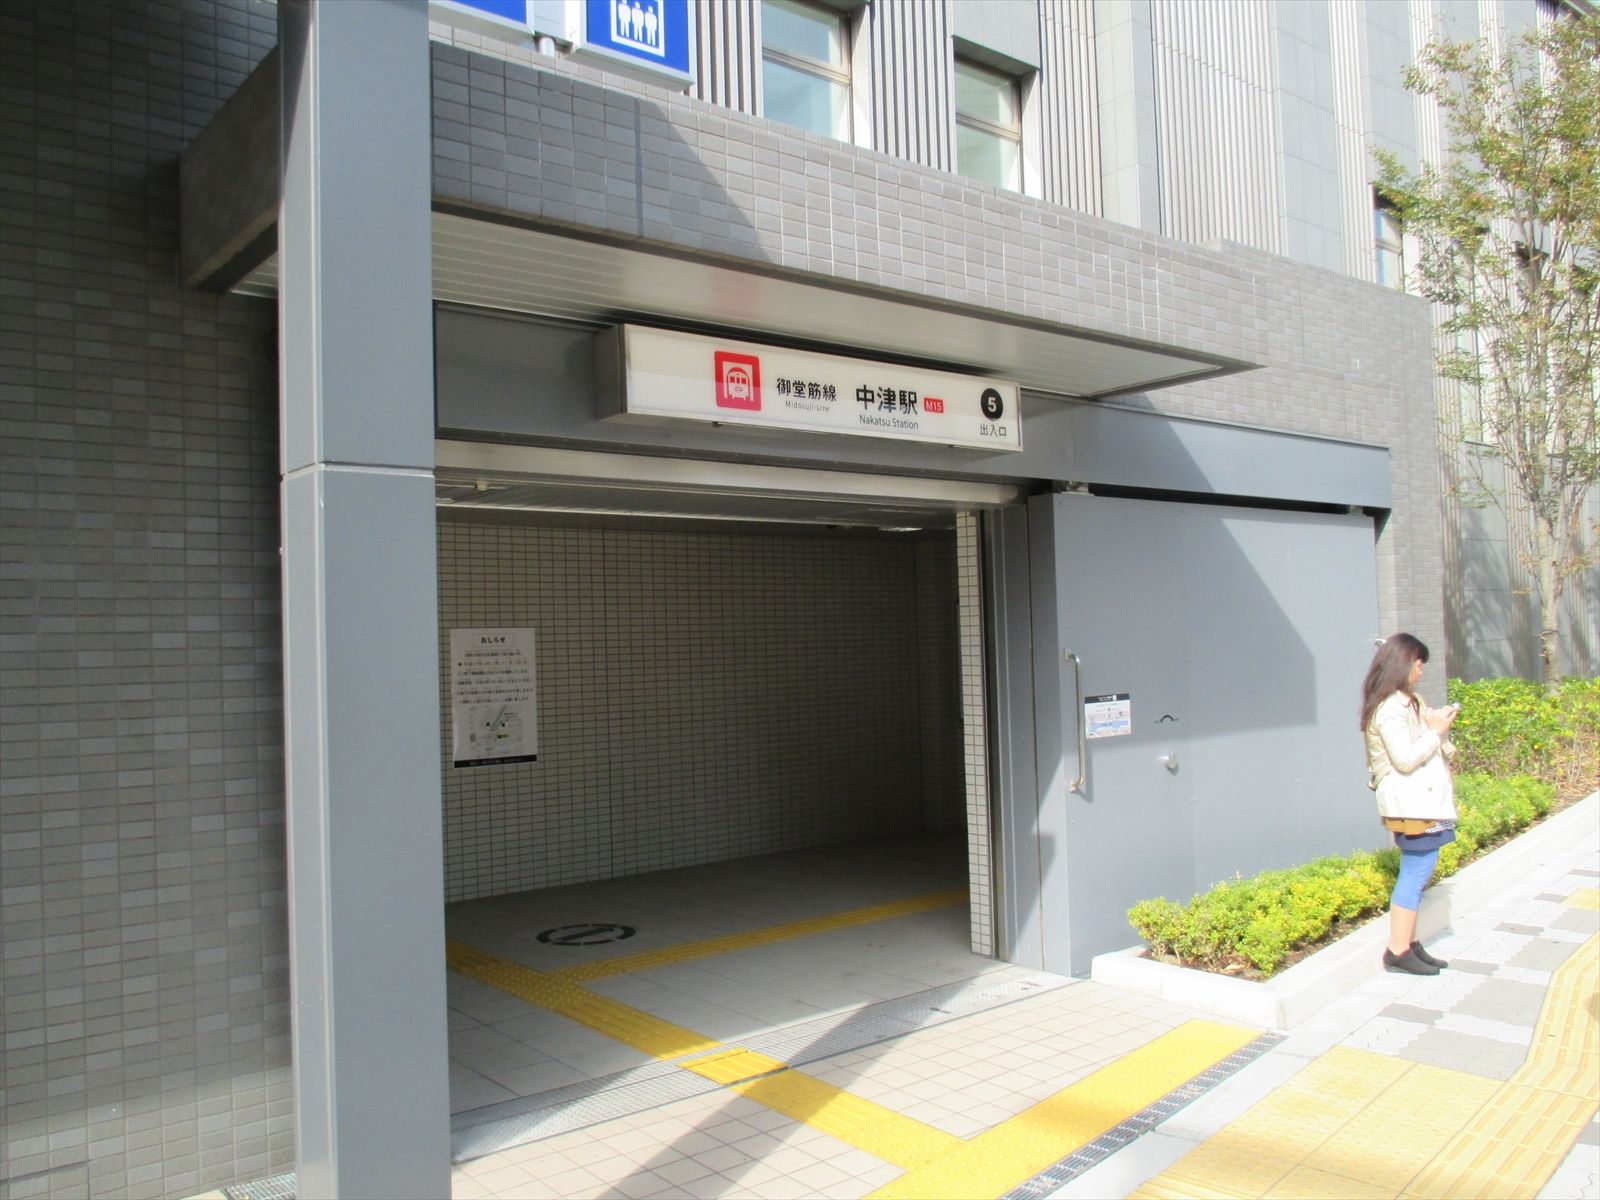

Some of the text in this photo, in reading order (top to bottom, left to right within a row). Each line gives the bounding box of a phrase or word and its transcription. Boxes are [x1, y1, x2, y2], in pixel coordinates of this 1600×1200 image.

[776, 378, 837, 402] 御堂筋線
[856, 384, 918, 415] 中津駅
[925, 401, 942, 412] M15
[987, 396, 997, 412] 5
[859, 414, 919, 430] Nakatsu Station
[980, 424, 1007, 437] 出入口
[481, 636, 506, 644] おしらせ
